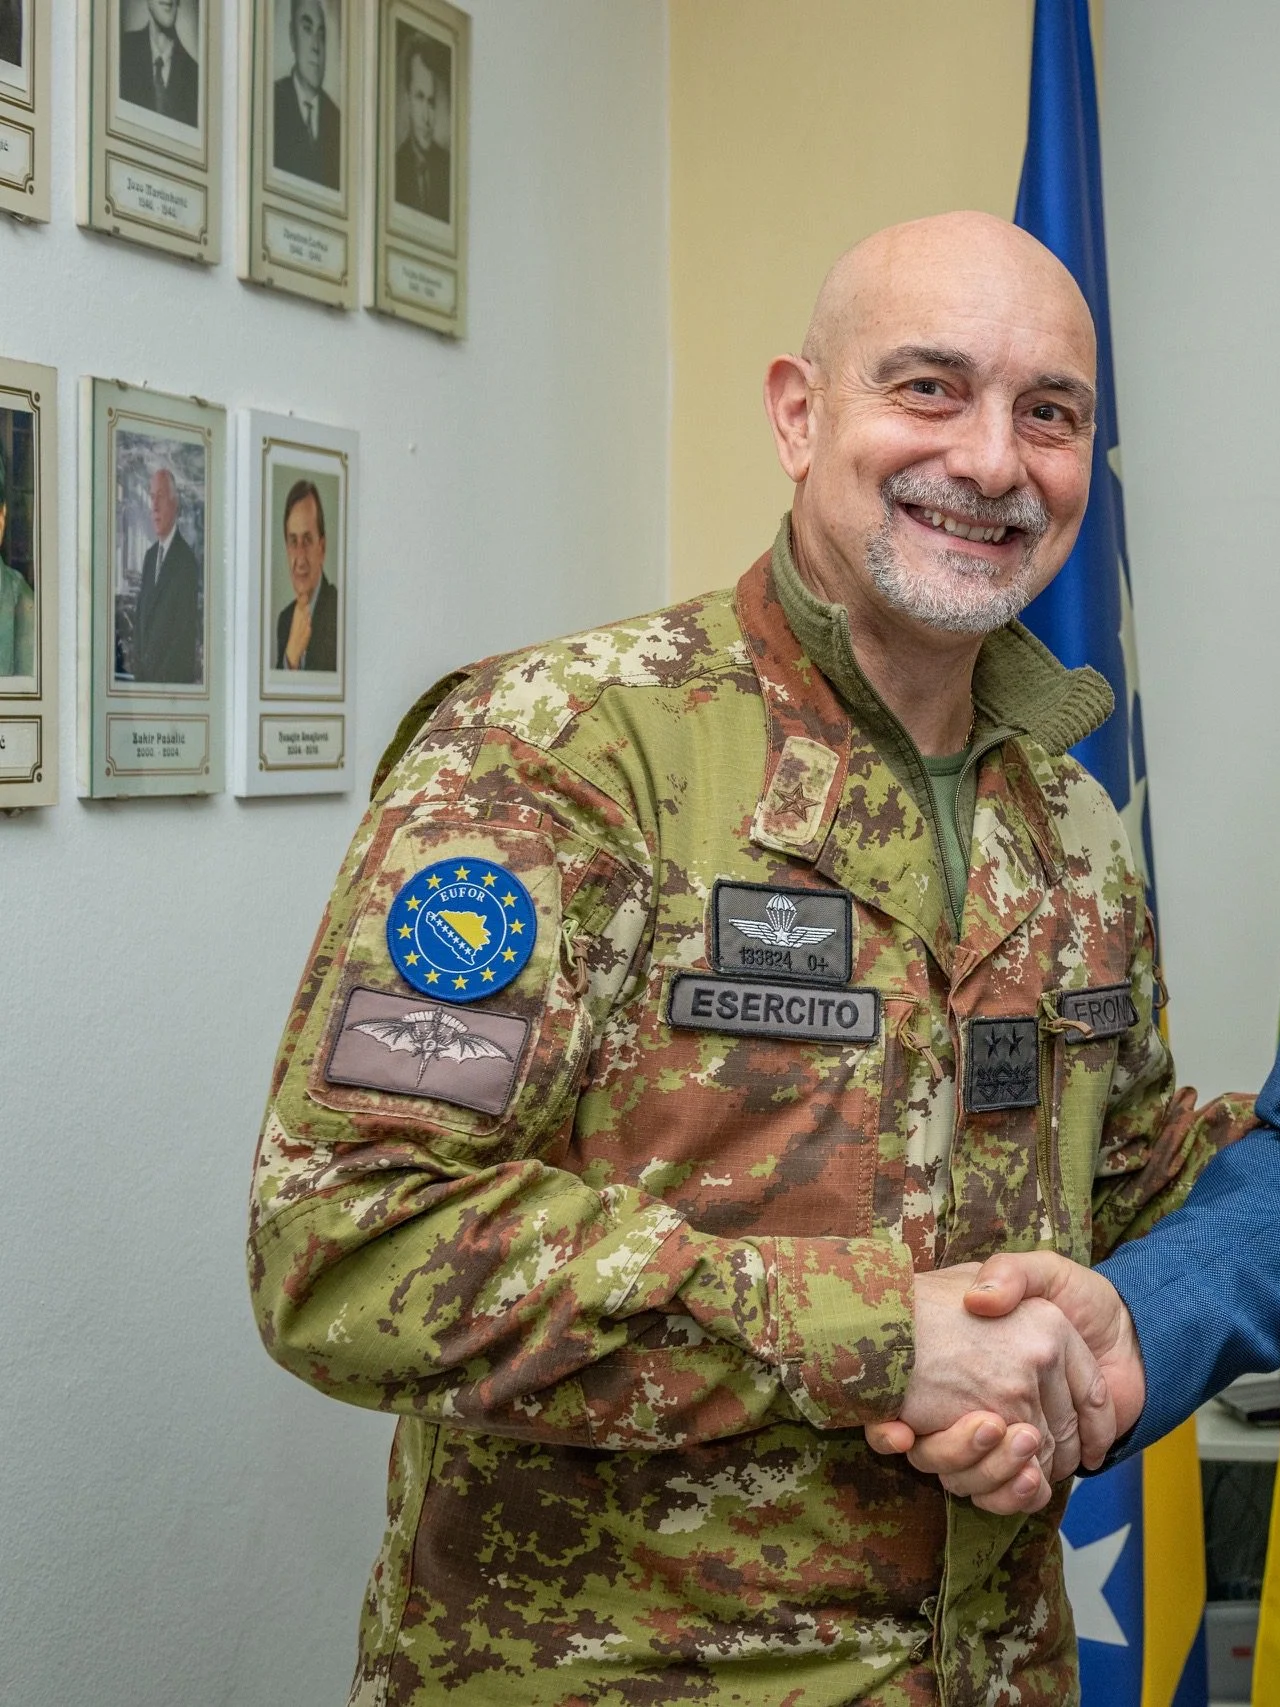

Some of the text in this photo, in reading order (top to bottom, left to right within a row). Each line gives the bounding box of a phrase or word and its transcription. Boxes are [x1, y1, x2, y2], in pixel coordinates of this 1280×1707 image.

[439, 887, 486, 903] EUFOR
[690, 987, 859, 1029] ESERCITO
[1073, 994, 1131, 1027] FRON
